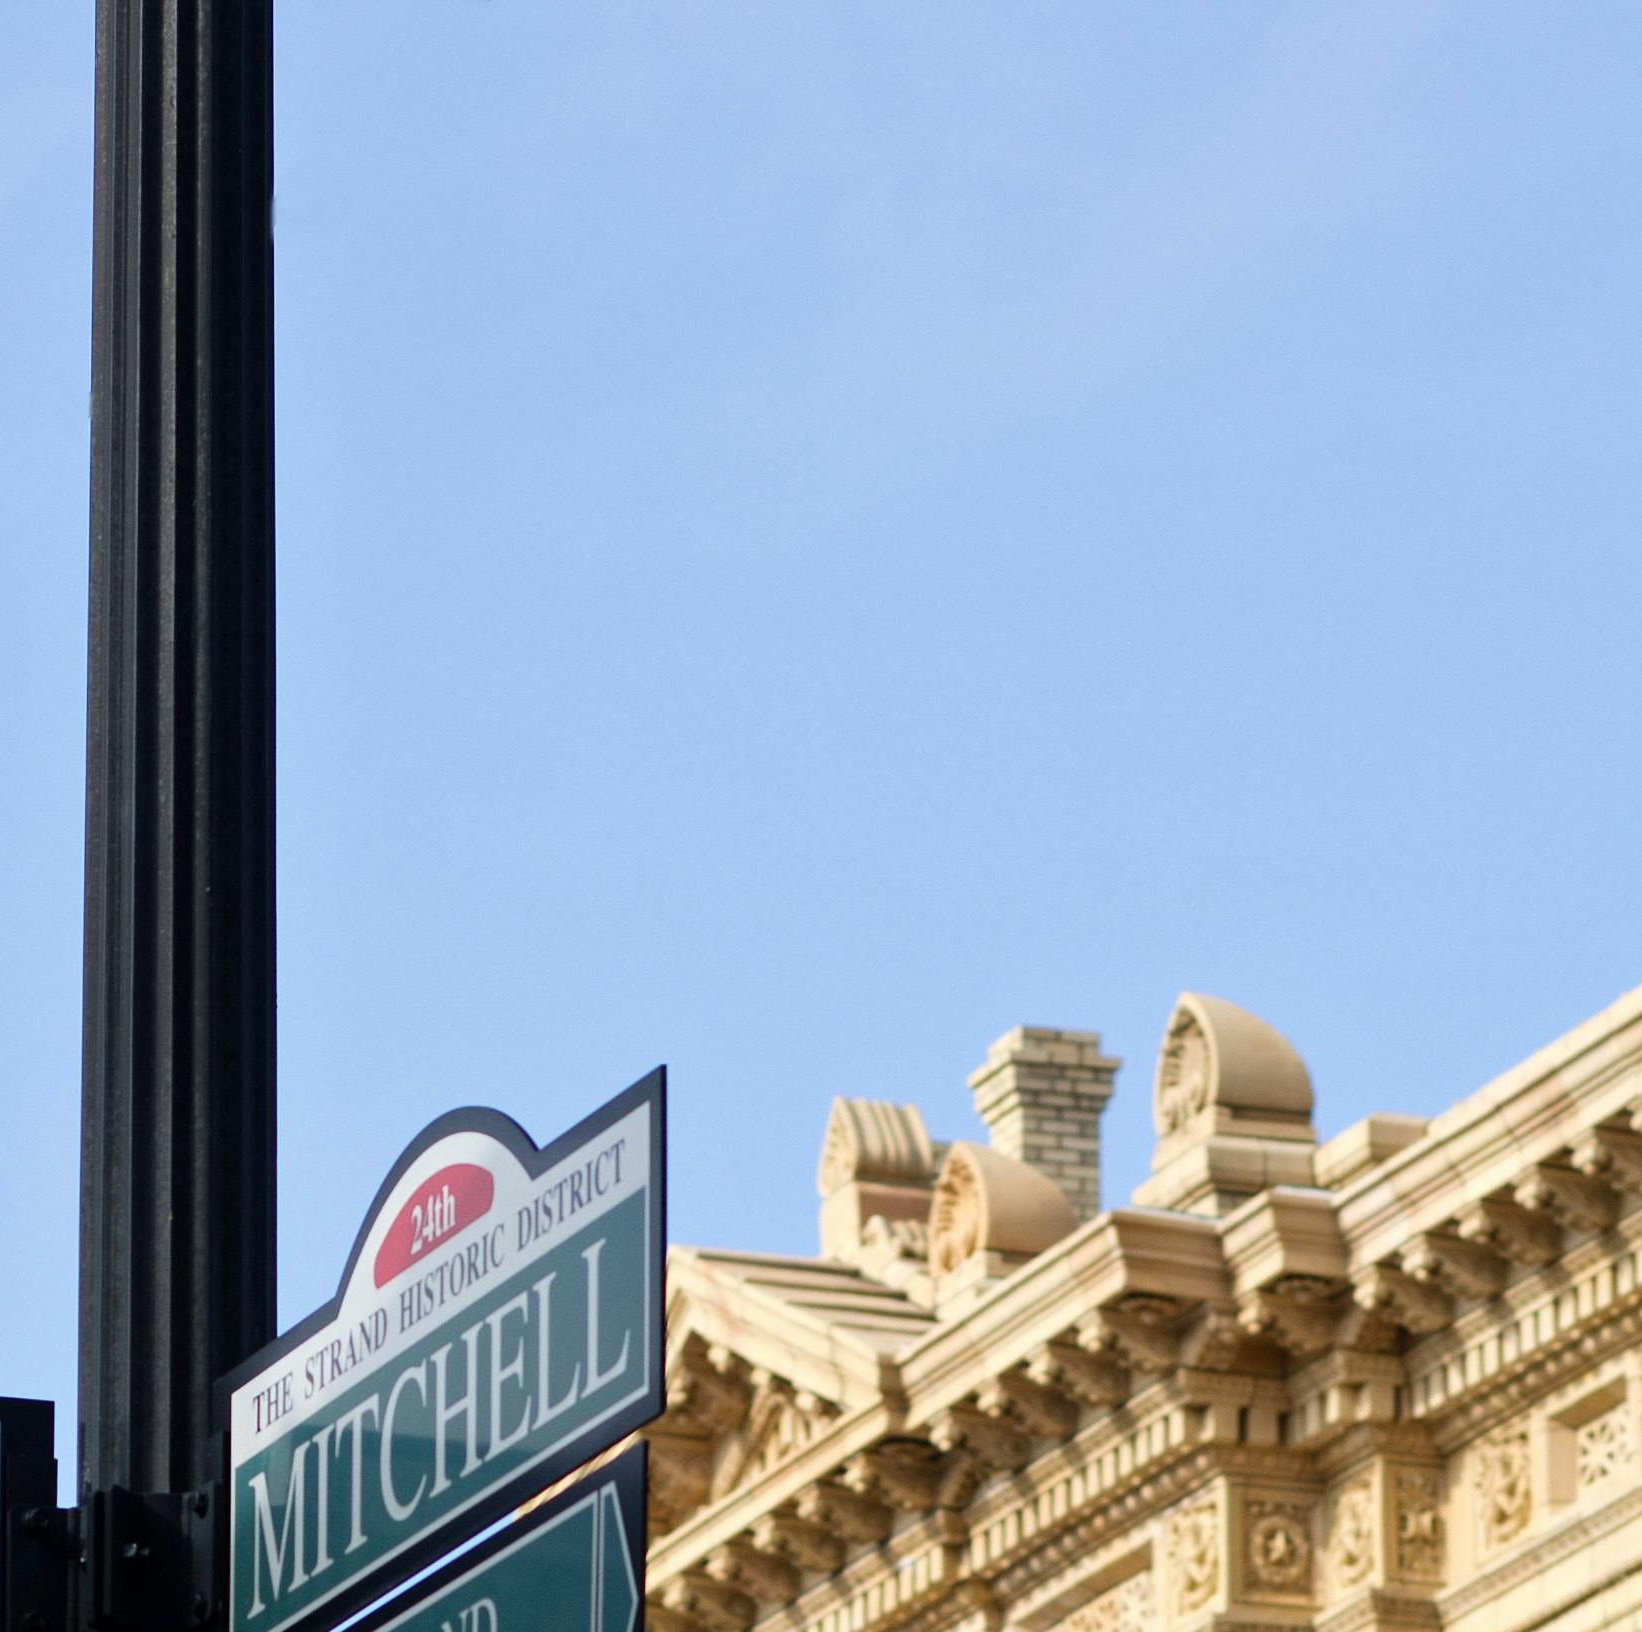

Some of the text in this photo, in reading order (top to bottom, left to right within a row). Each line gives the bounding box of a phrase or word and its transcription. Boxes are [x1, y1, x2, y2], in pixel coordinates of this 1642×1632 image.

[253, 1139, 626, 1434] THE STRAND HISTORIC DISTRICT
[410, 1184, 456, 1255] 24th
[248, 1238, 630, 1619] MITCHELL
